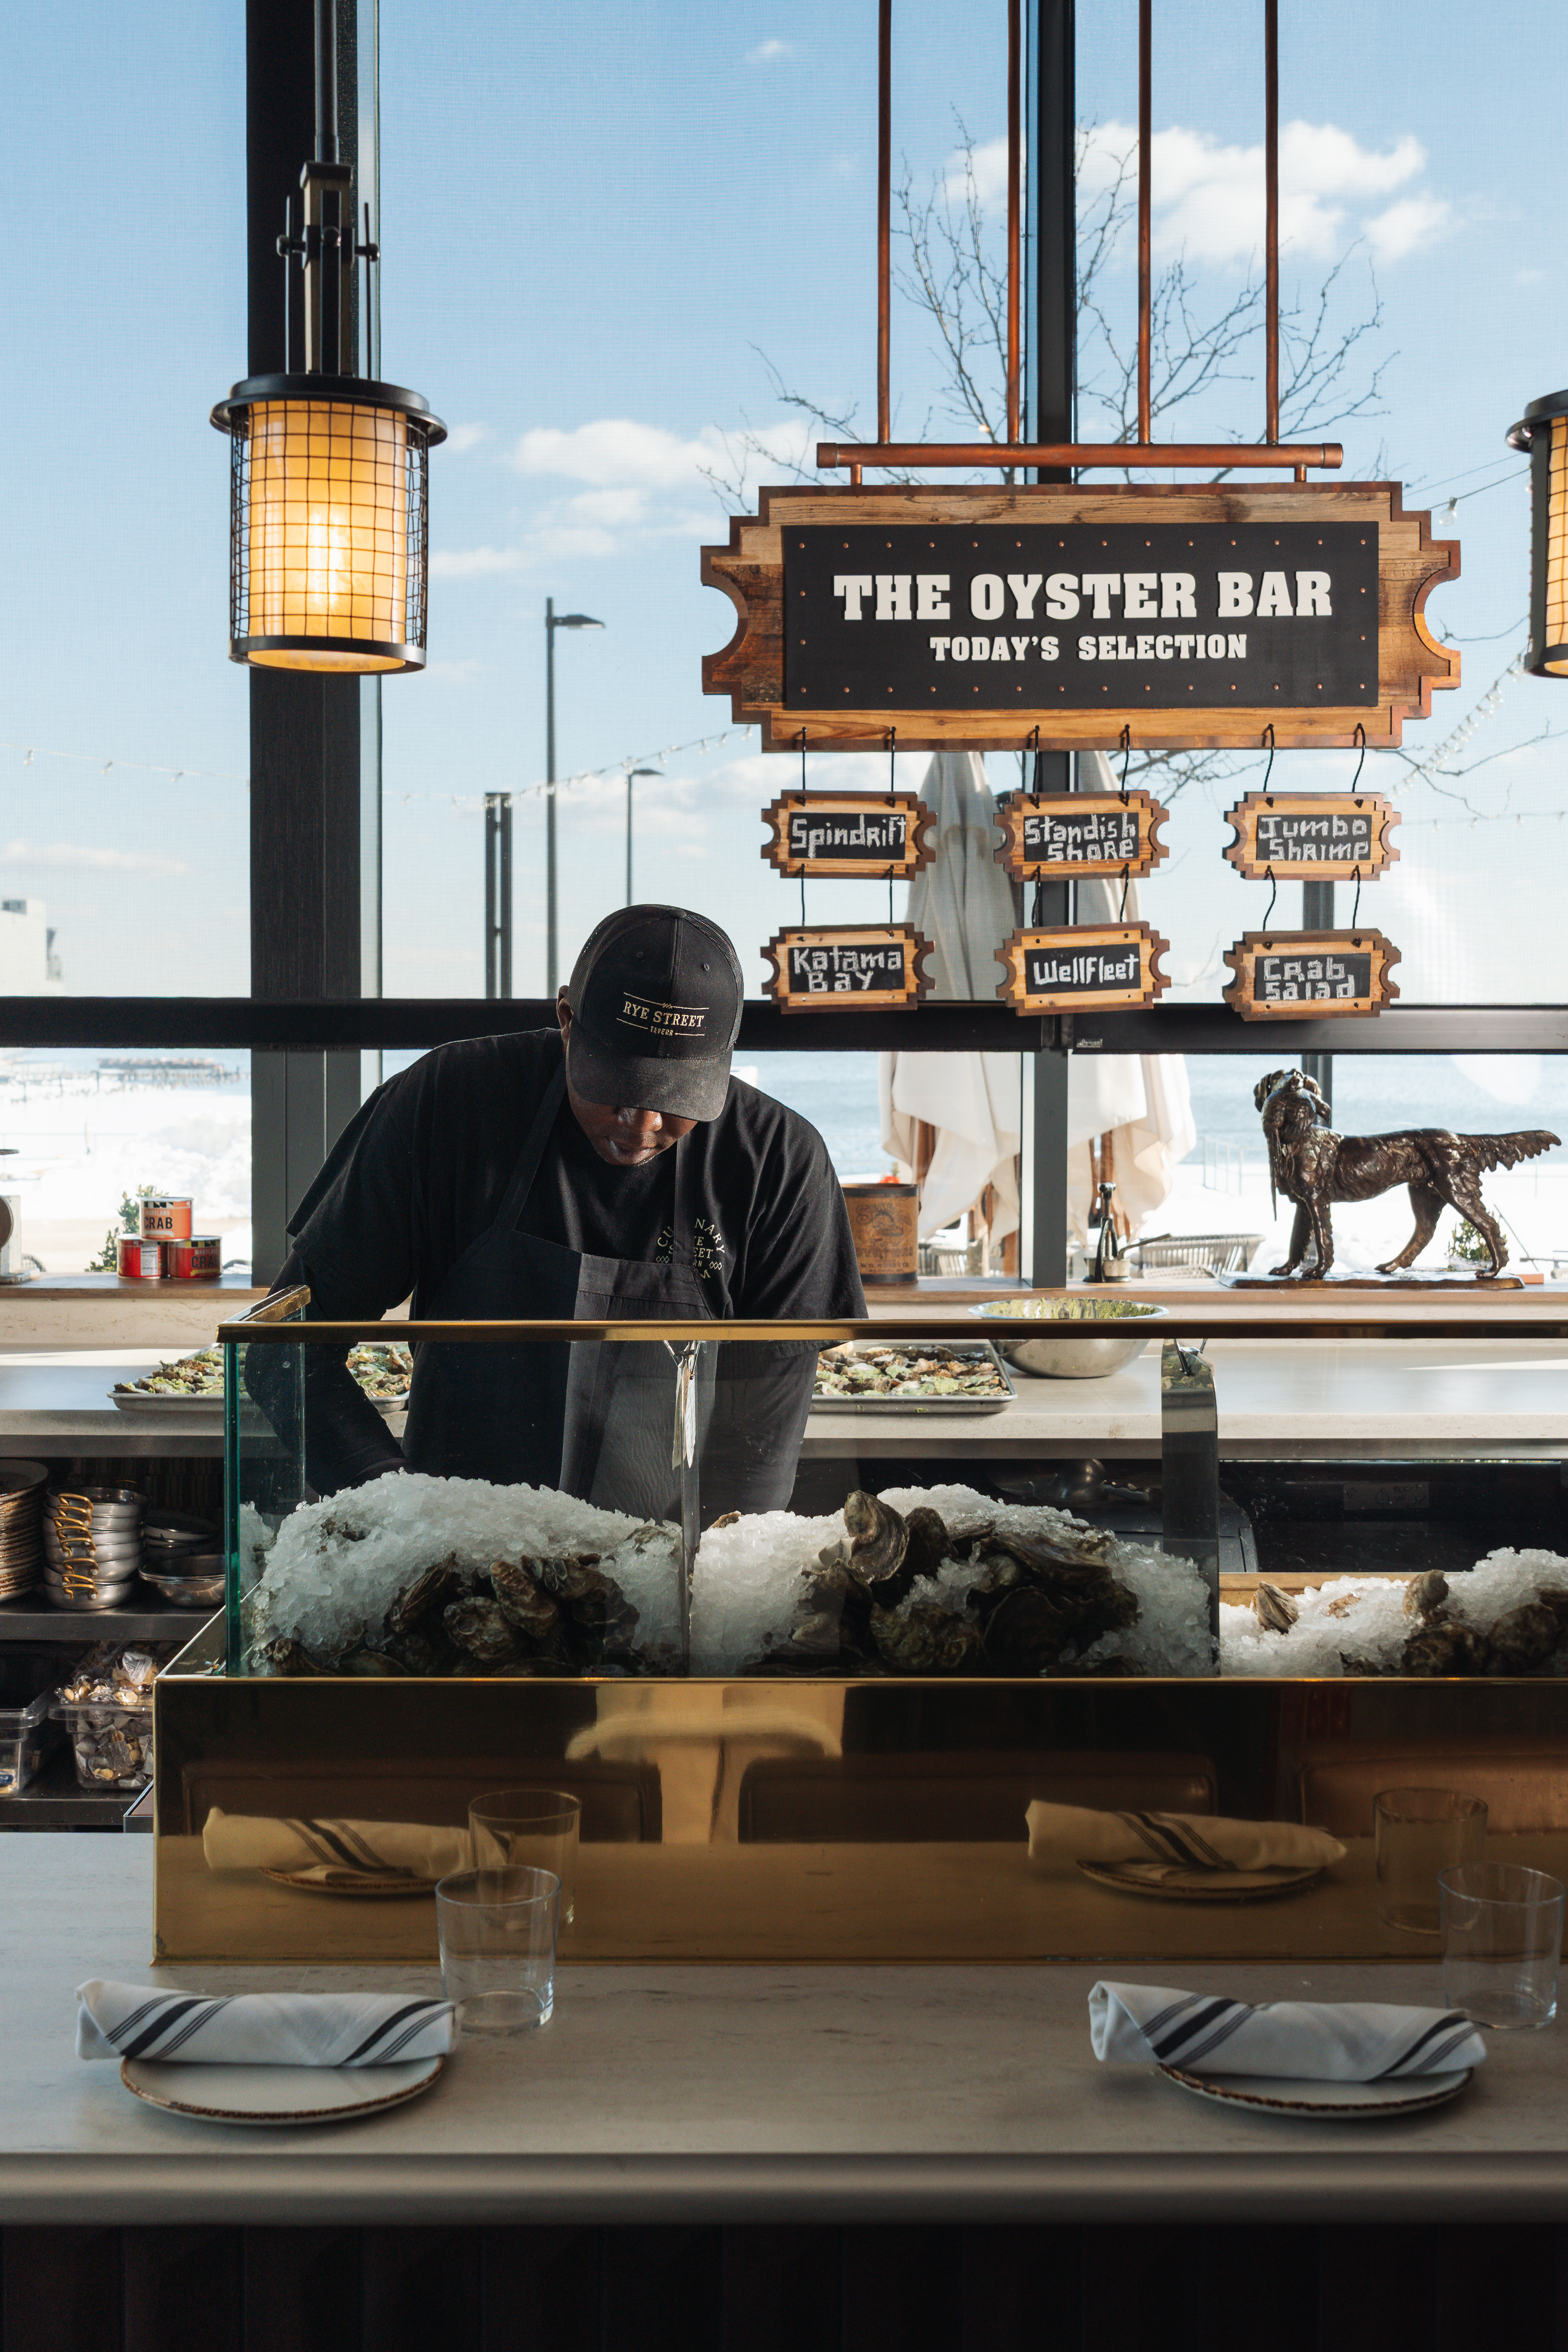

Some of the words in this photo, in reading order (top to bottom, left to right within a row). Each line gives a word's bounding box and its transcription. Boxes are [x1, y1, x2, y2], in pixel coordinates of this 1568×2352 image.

[834, 574, 951, 620] THE
[970, 572, 1197, 620] OYSTER
[1217, 571, 1332, 617] BAR
[930, 636, 1059, 661] TODAY'S
[1078, 634, 1247, 660] SELECTION
[1024, 812, 1136, 845] Standish
[1258, 814, 1367, 839] Jumbo
[793, 946, 902, 974] Katama
[622, 1001, 650, 1020] RYE
[653, 1011, 705, 1027] STREET
[650, 1026, 674, 1036] TAVERN
[144, 1216, 173, 1229] CRAB
[658, 1218, 725, 1253] CUNARY
